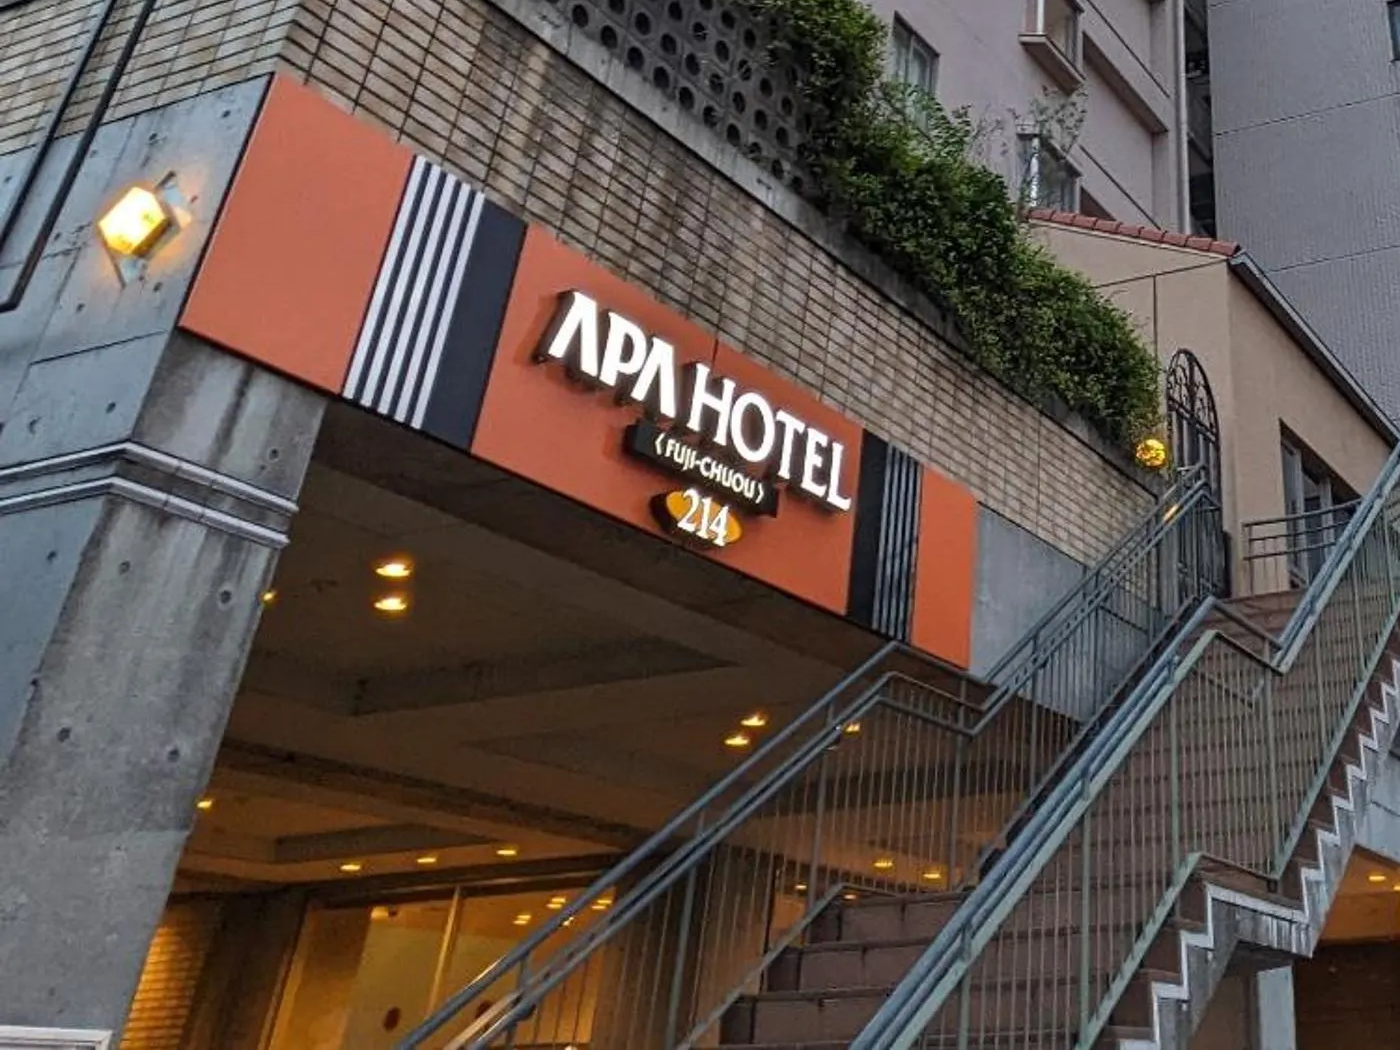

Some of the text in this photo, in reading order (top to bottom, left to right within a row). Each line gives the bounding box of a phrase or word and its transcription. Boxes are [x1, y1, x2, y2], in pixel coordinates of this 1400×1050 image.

[547, 291, 851, 511] APA HOTEL
[677, 488, 728, 547] 214
